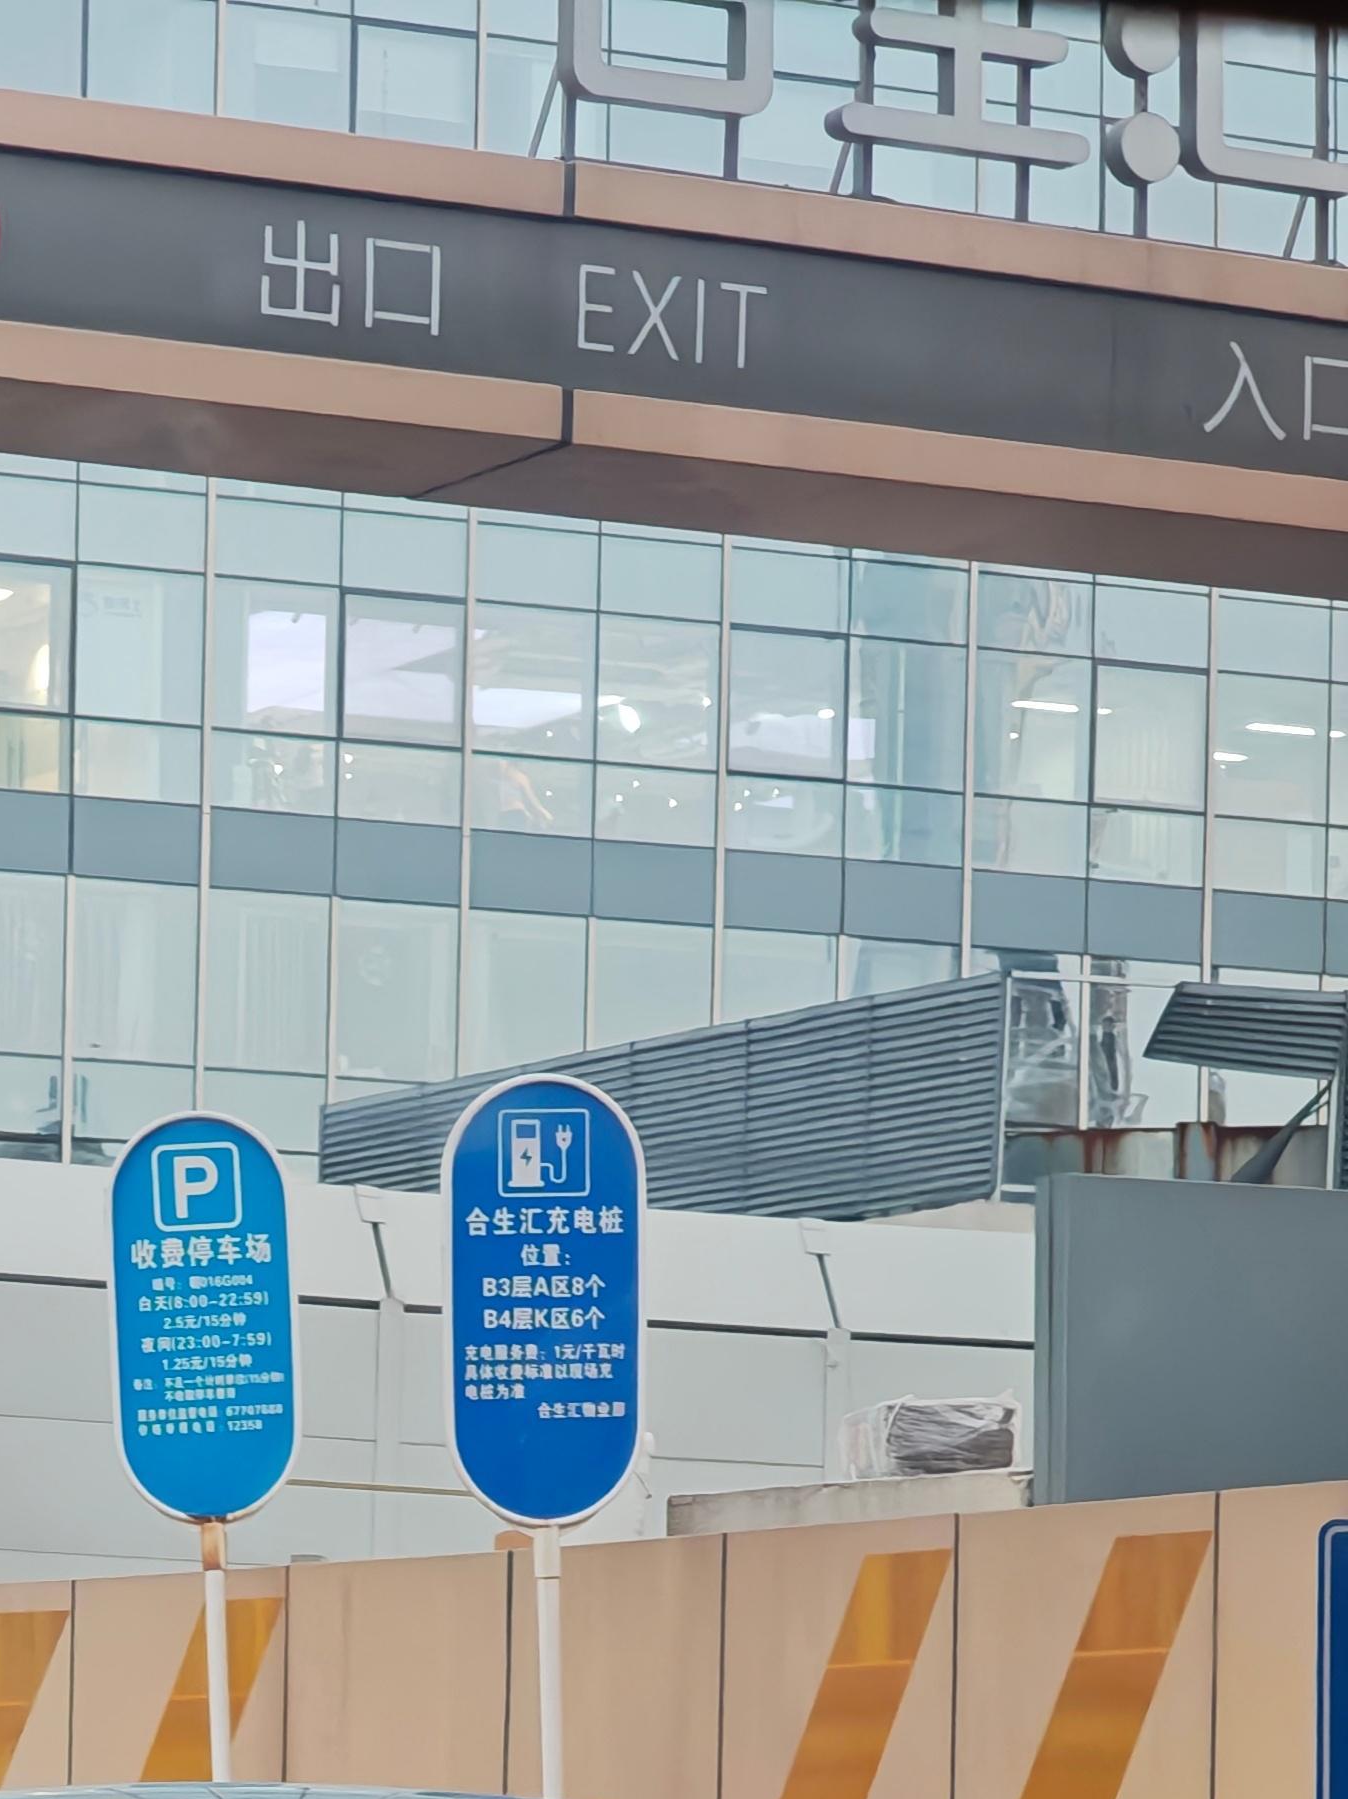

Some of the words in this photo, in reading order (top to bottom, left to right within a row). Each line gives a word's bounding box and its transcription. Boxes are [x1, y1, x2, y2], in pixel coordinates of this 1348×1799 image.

[260, 220, 441, 336] 出口
[576, 264, 768, 369] EXIT
[172, 1155, 219, 1219] P
[465, 1205, 624, 1237] 合生汇充电桩
[130, 1232, 272, 1270] 收费停车场
[482, 1274, 606, 1299] B3层A区8个
[483, 1306, 606, 1330] B4层K区6个
